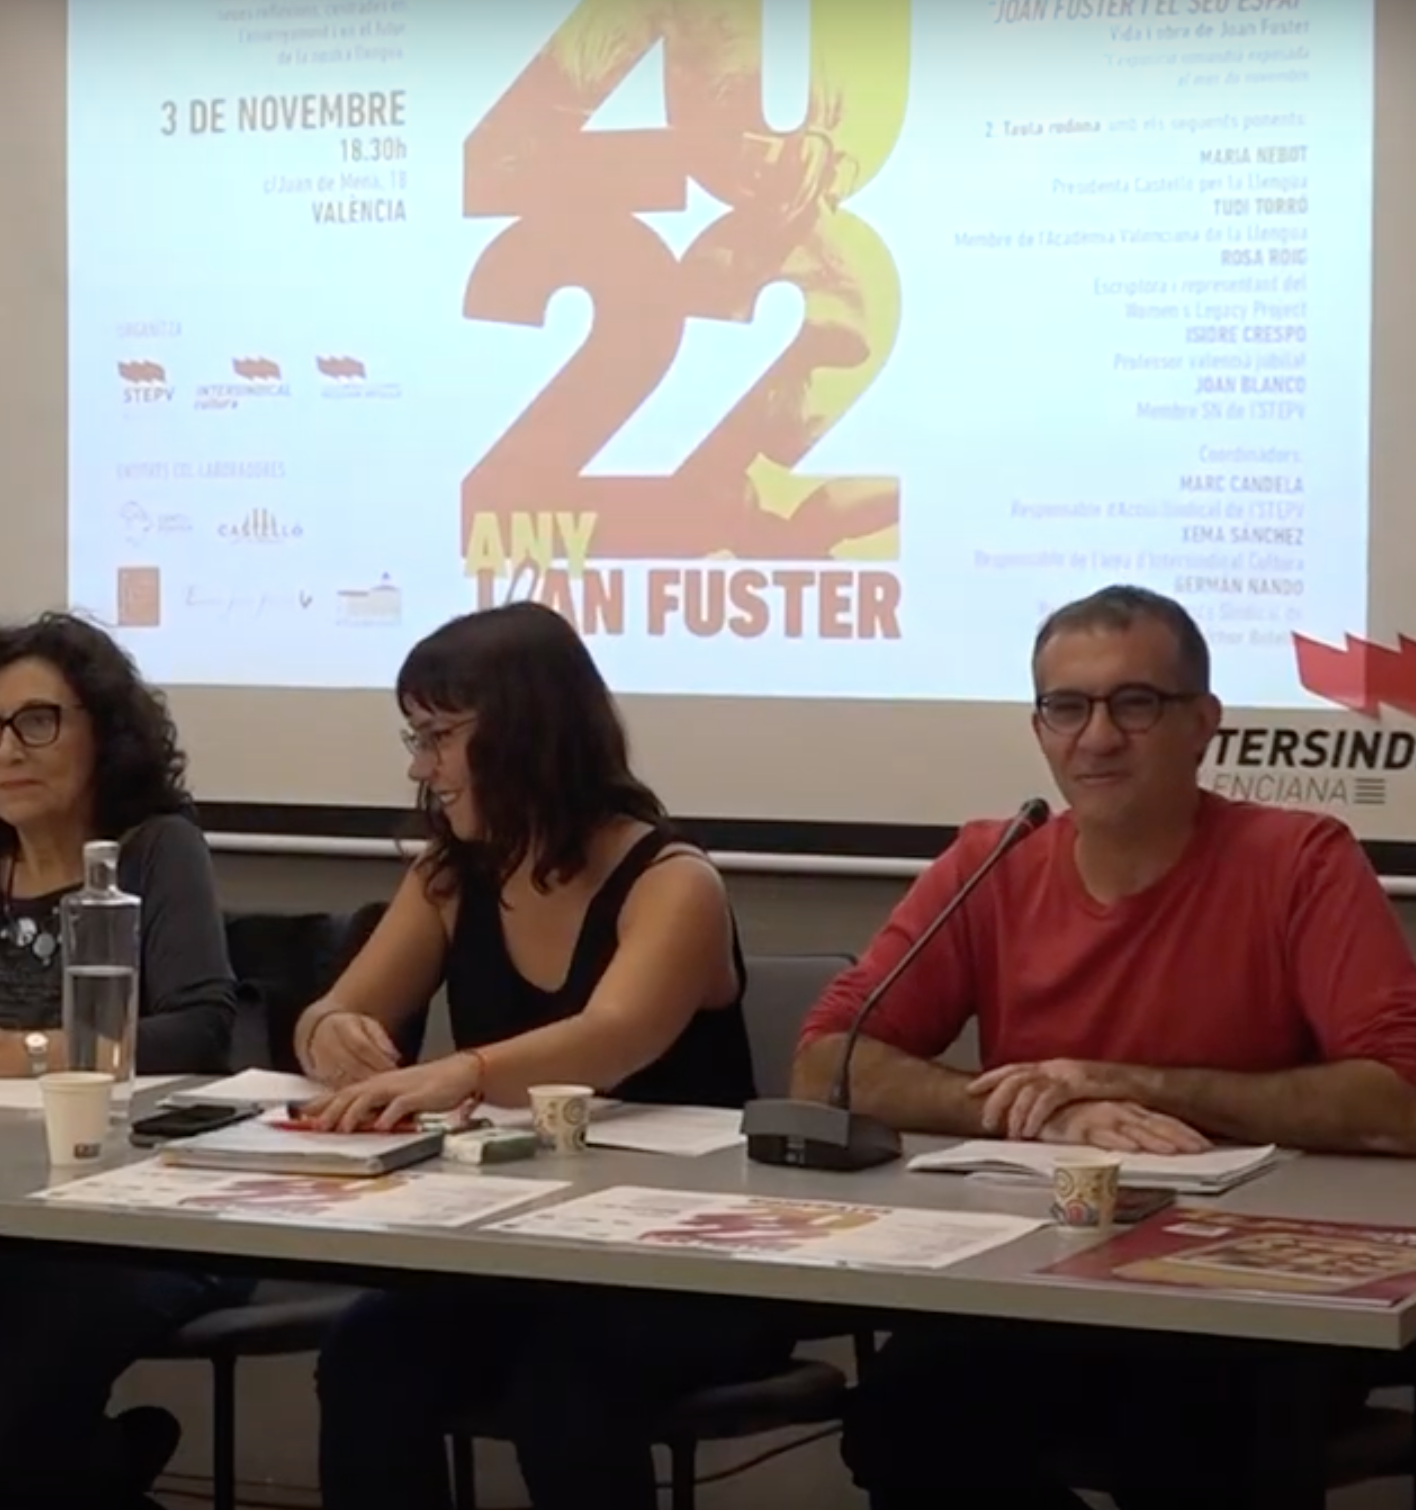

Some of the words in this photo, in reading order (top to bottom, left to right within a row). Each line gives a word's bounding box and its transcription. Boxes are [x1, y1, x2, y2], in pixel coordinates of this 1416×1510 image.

[1051, 0, 1134, 21] FUSTER
[1194, 21, 1214, 39] de
[1219, 20, 1257, 38] Joan
[1260, 17, 1310, 37] Fuster
[160, 100, 178, 136] 3
[188, 97, 227, 134] DE
[236, 89, 407, 132] NOVEMBRE
[1048, 116, 1102, 135] rodona
[338, 136, 408, 163] 18.30h
[1198, 146, 1252, 166] MARIA
[1255, 144, 1309, 164] NEBOT
[317, 173, 336, 192] de
[1198, 175, 1223, 195] per
[1227, 173, 1244, 191] la
[311, 194, 408, 225] VALÈNCIA
[1212, 198, 1251, 217] TUDI
[1016, 230, 1035, 249] de
[1203, 226, 1223, 244] de
[1226, 226, 1244, 243] la
[1220, 247, 1265, 267] ROSA
[1268, 246, 1308, 266] ROIG
[1282, 272, 1307, 292] del
[1241, 324, 1307, 344] CRESPO
[460, 206, 902, 560] 22
[1193, 376, 1237, 396] JOAN
[1239, 375, 1307, 395] BLANCO
[122, 386, 175, 405] STEPV
[1178, 474, 1225, 494] MARC
[1229, 474, 1305, 494] CANDELA
[464, 511, 598, 578] ANY
[1181, 527, 1225, 545] XEMA
[1247, 577, 1304, 598] NANDO
[646, 567, 902, 639] FUSTER
[1215, 728, 1416, 770] TERSIND
[1213, 774, 1348, 804] ENCIANA
